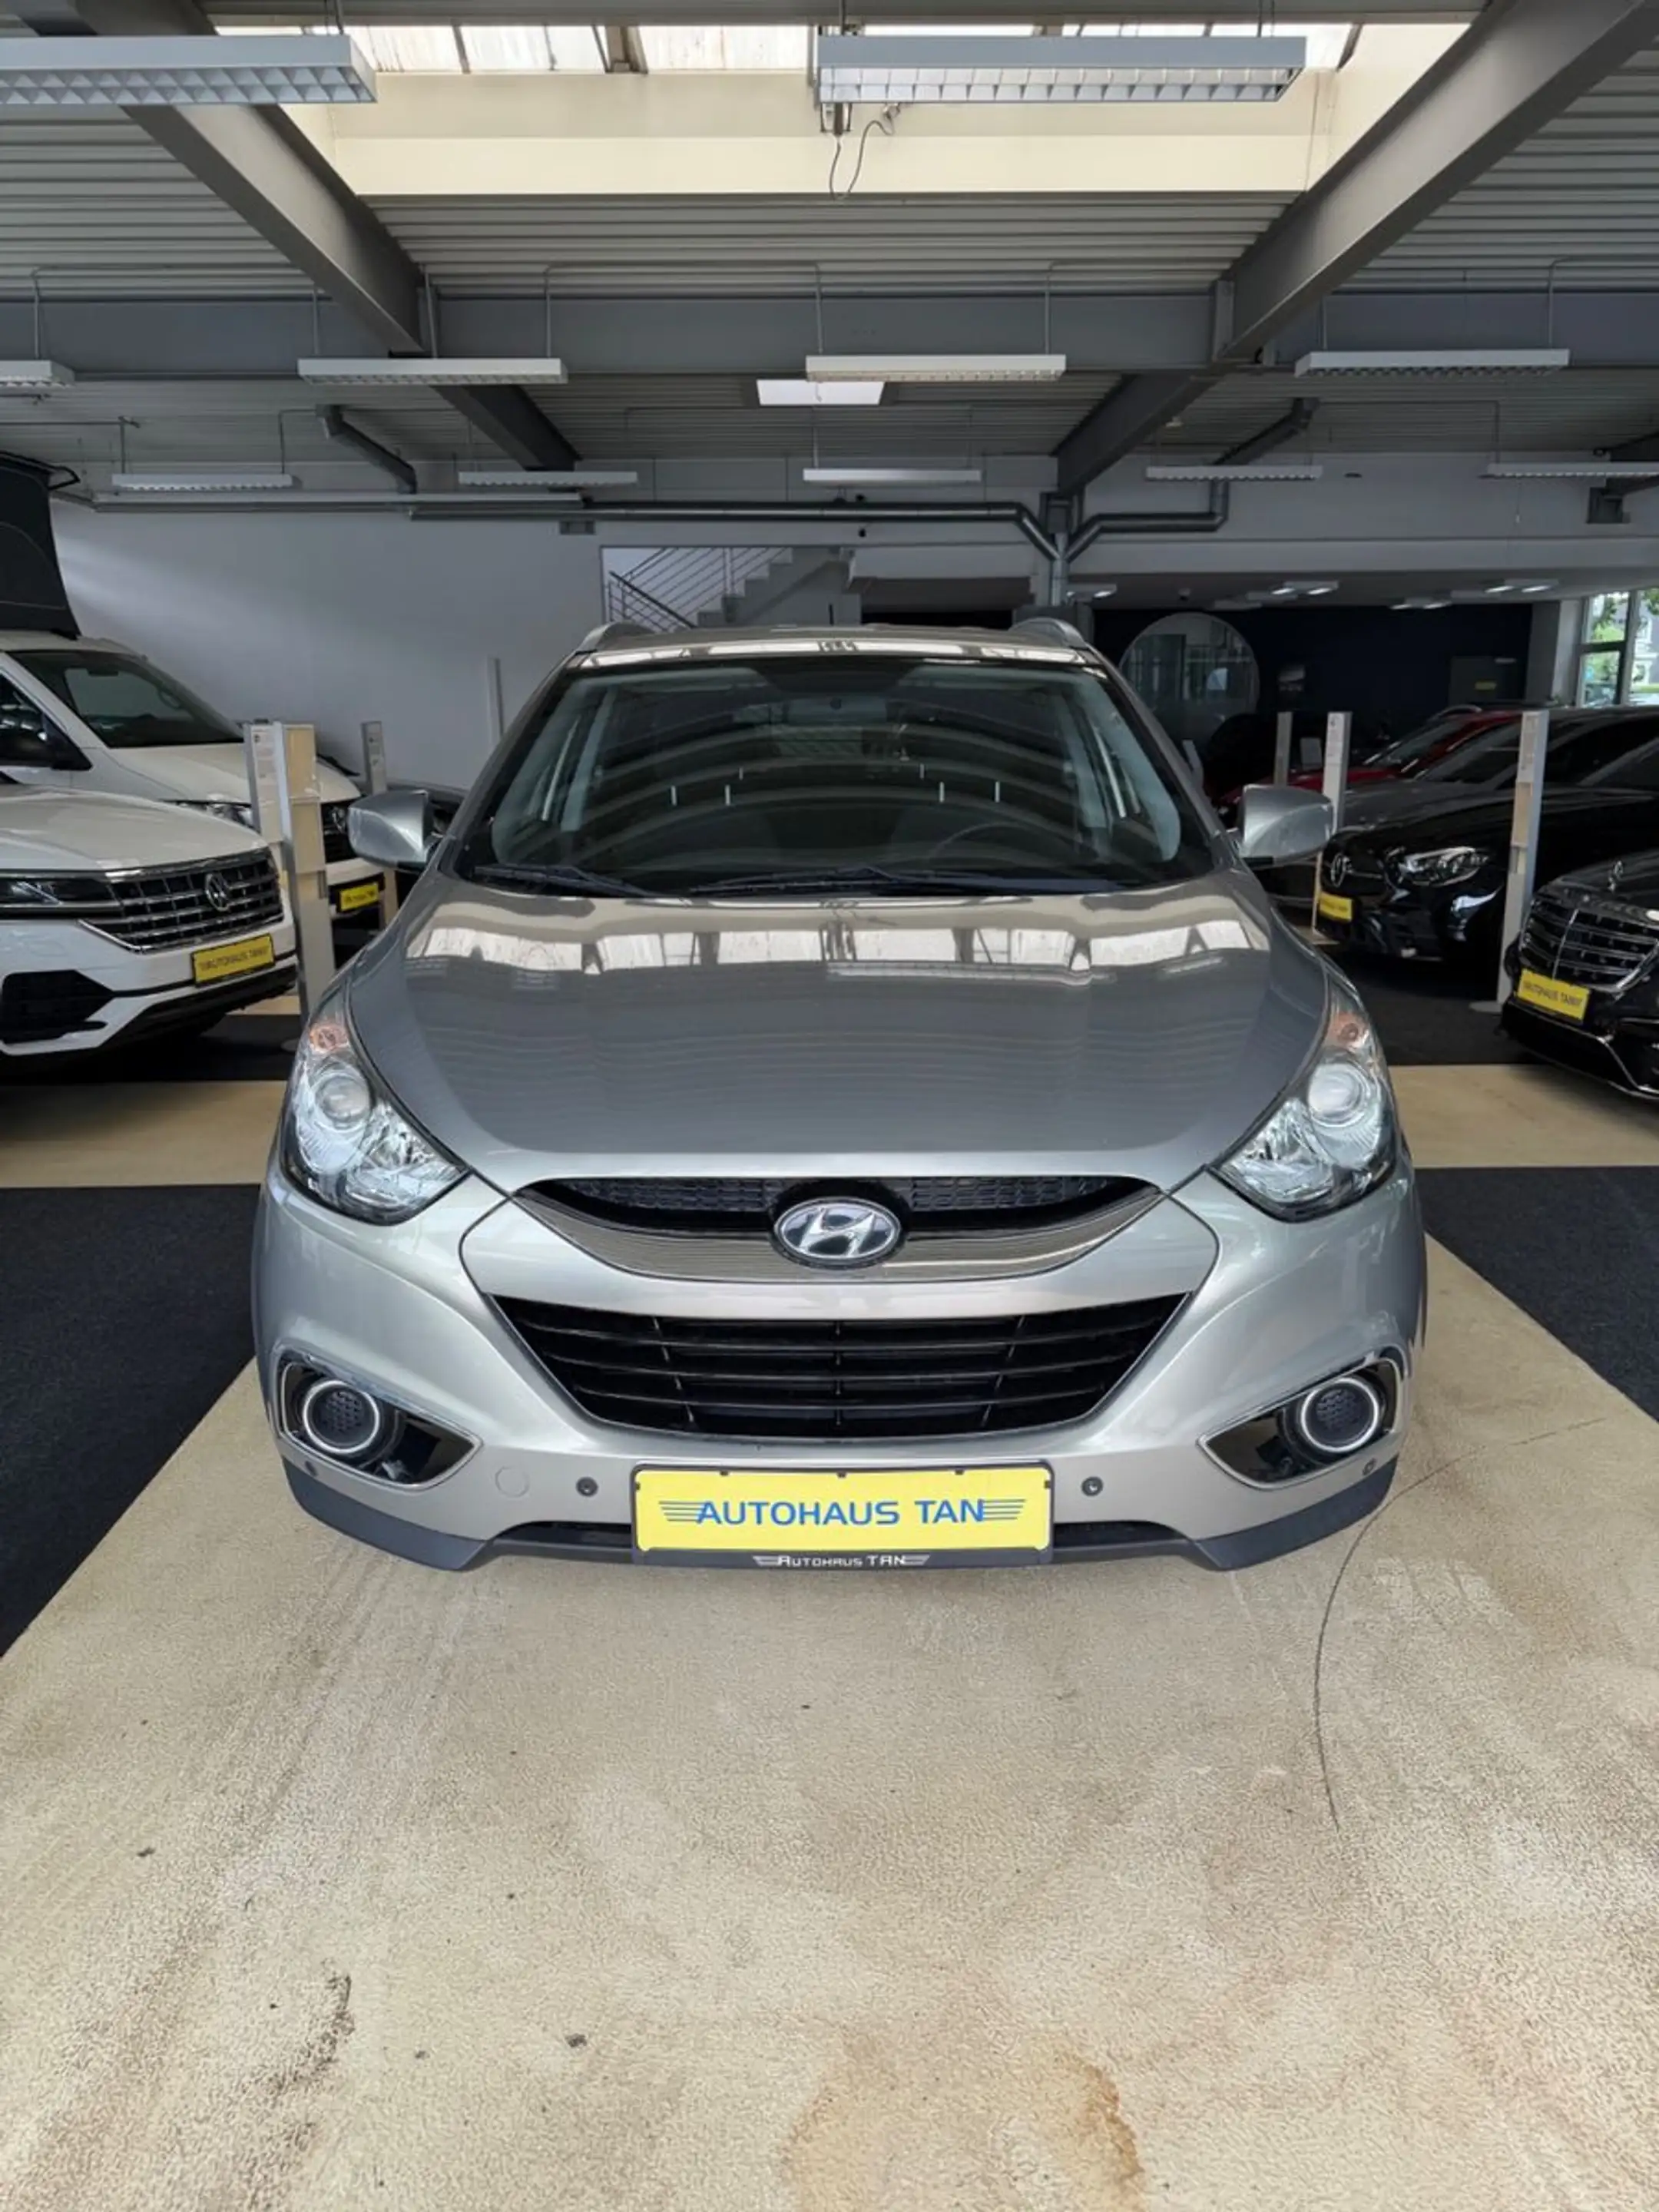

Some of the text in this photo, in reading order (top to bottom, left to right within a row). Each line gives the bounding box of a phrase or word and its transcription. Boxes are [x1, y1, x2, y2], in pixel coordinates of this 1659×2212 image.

[697, 1498, 985, 1526] AUTOHAUS TAN
[866, 1554, 905, 1567] TAN
